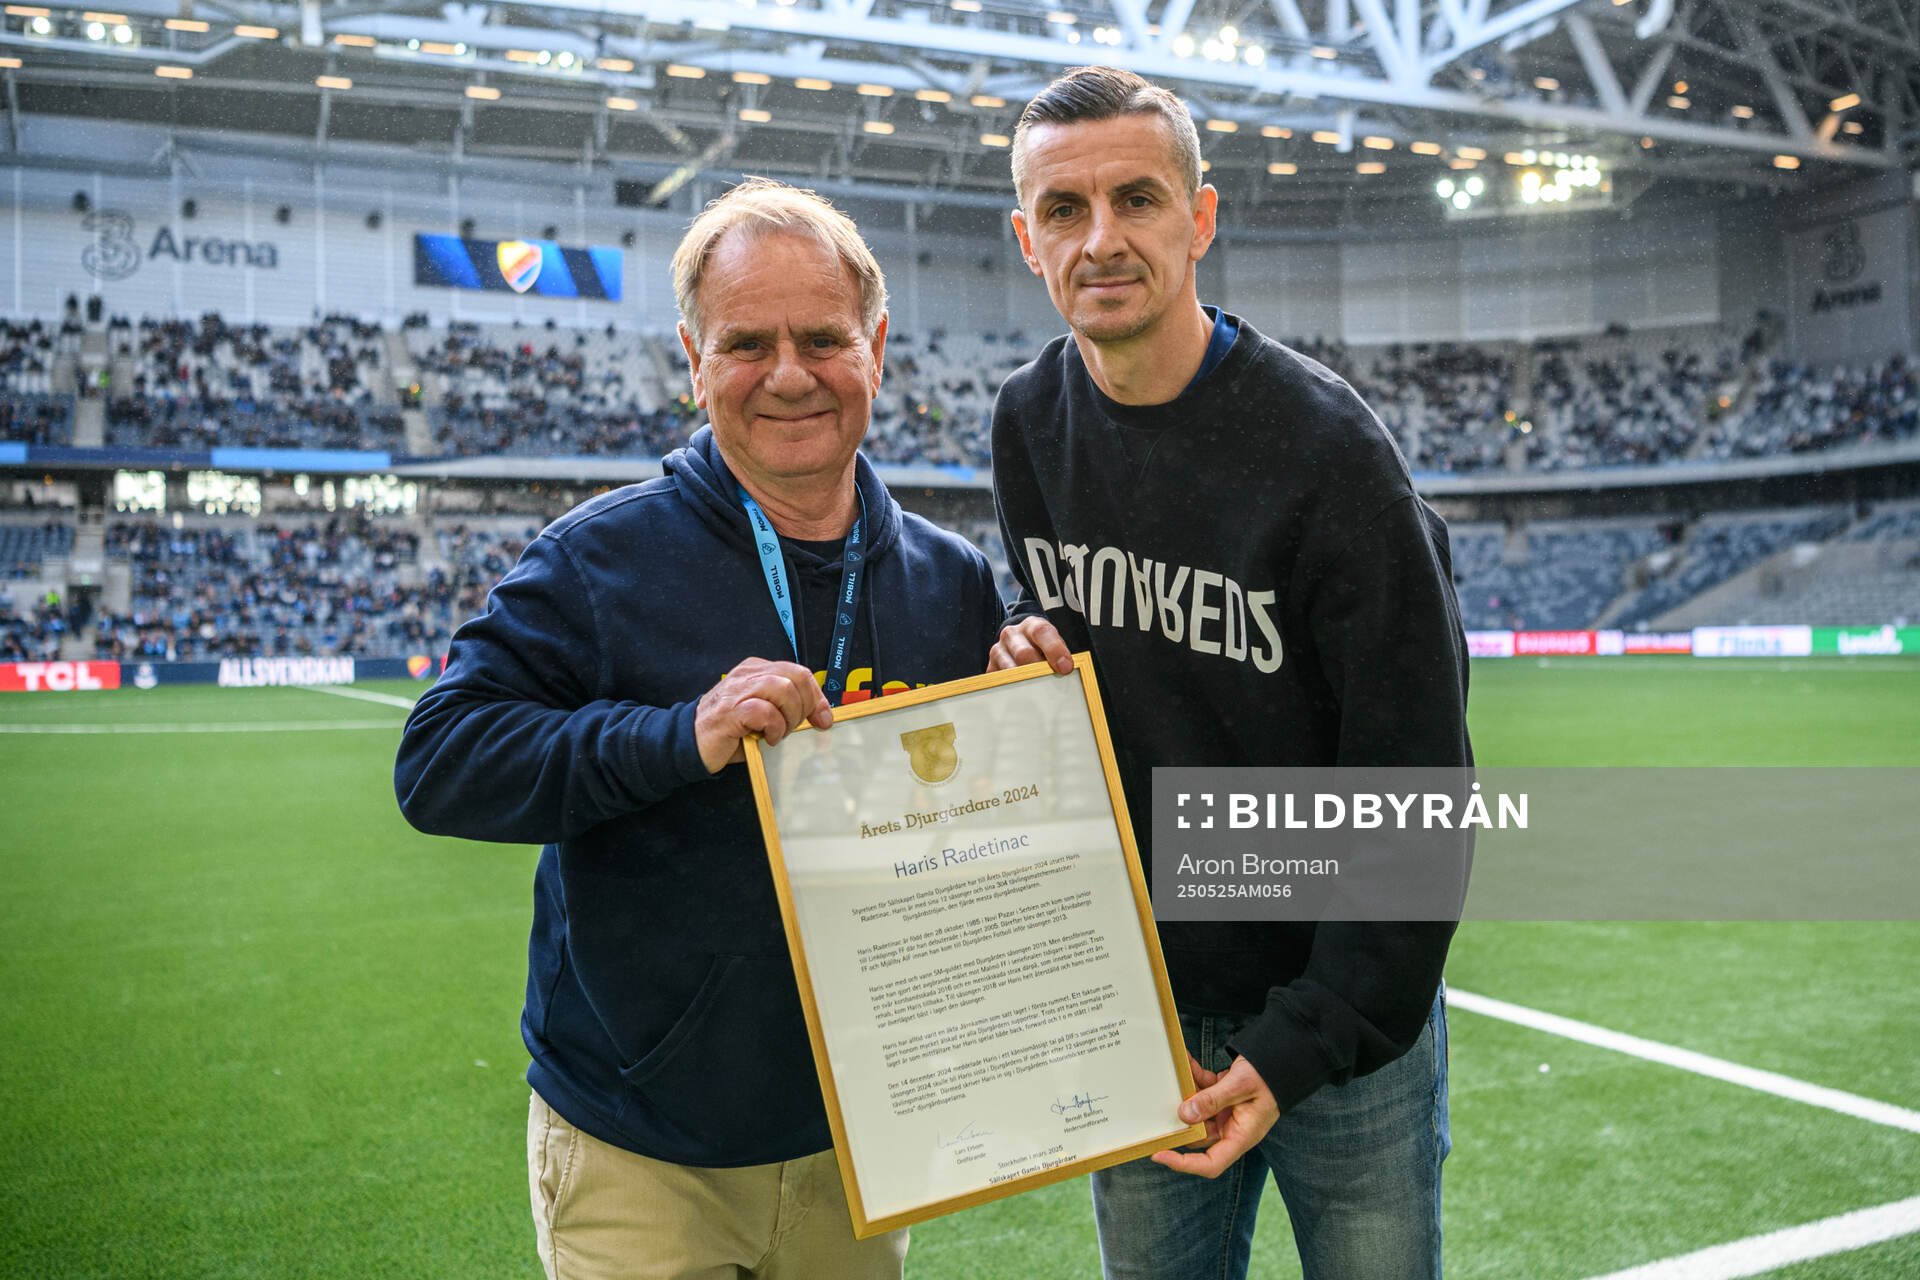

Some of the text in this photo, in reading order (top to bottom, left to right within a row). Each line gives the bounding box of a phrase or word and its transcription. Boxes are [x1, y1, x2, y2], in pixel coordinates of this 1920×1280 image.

[150, 226, 278, 268] Arena
[17, 663, 102, 690] TCL
[860, 784, 1040, 839] Årets Djurgårdare 2024
[894, 833, 1029, 878] Haris Radetinac
